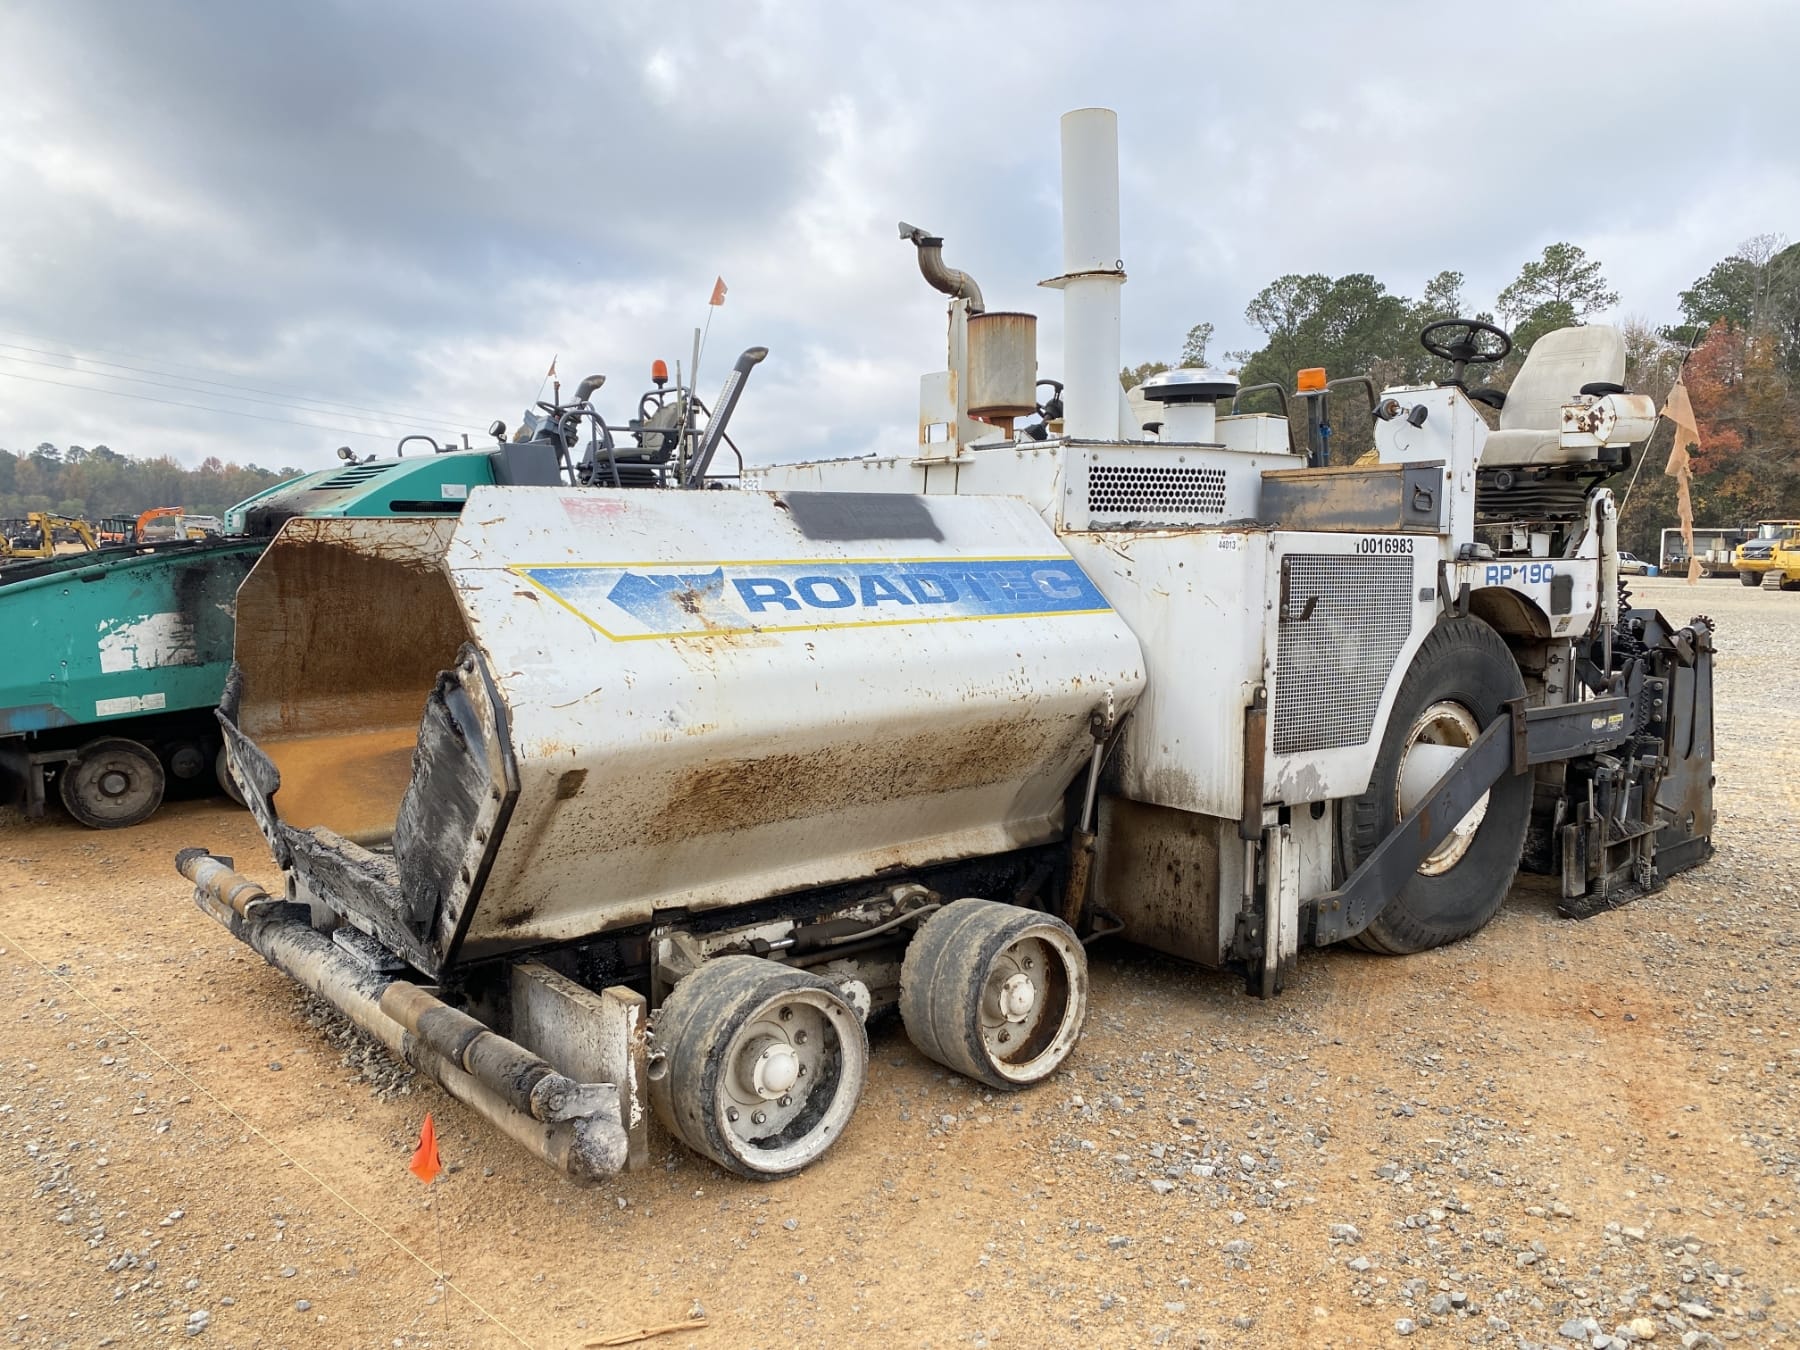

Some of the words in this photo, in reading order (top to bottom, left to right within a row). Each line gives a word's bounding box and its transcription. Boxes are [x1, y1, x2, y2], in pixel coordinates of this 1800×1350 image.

[731, 569, 1084, 613] ROADTEC
[1485, 565, 1513, 586] RP
[1519, 563, 1554, 585] 190
